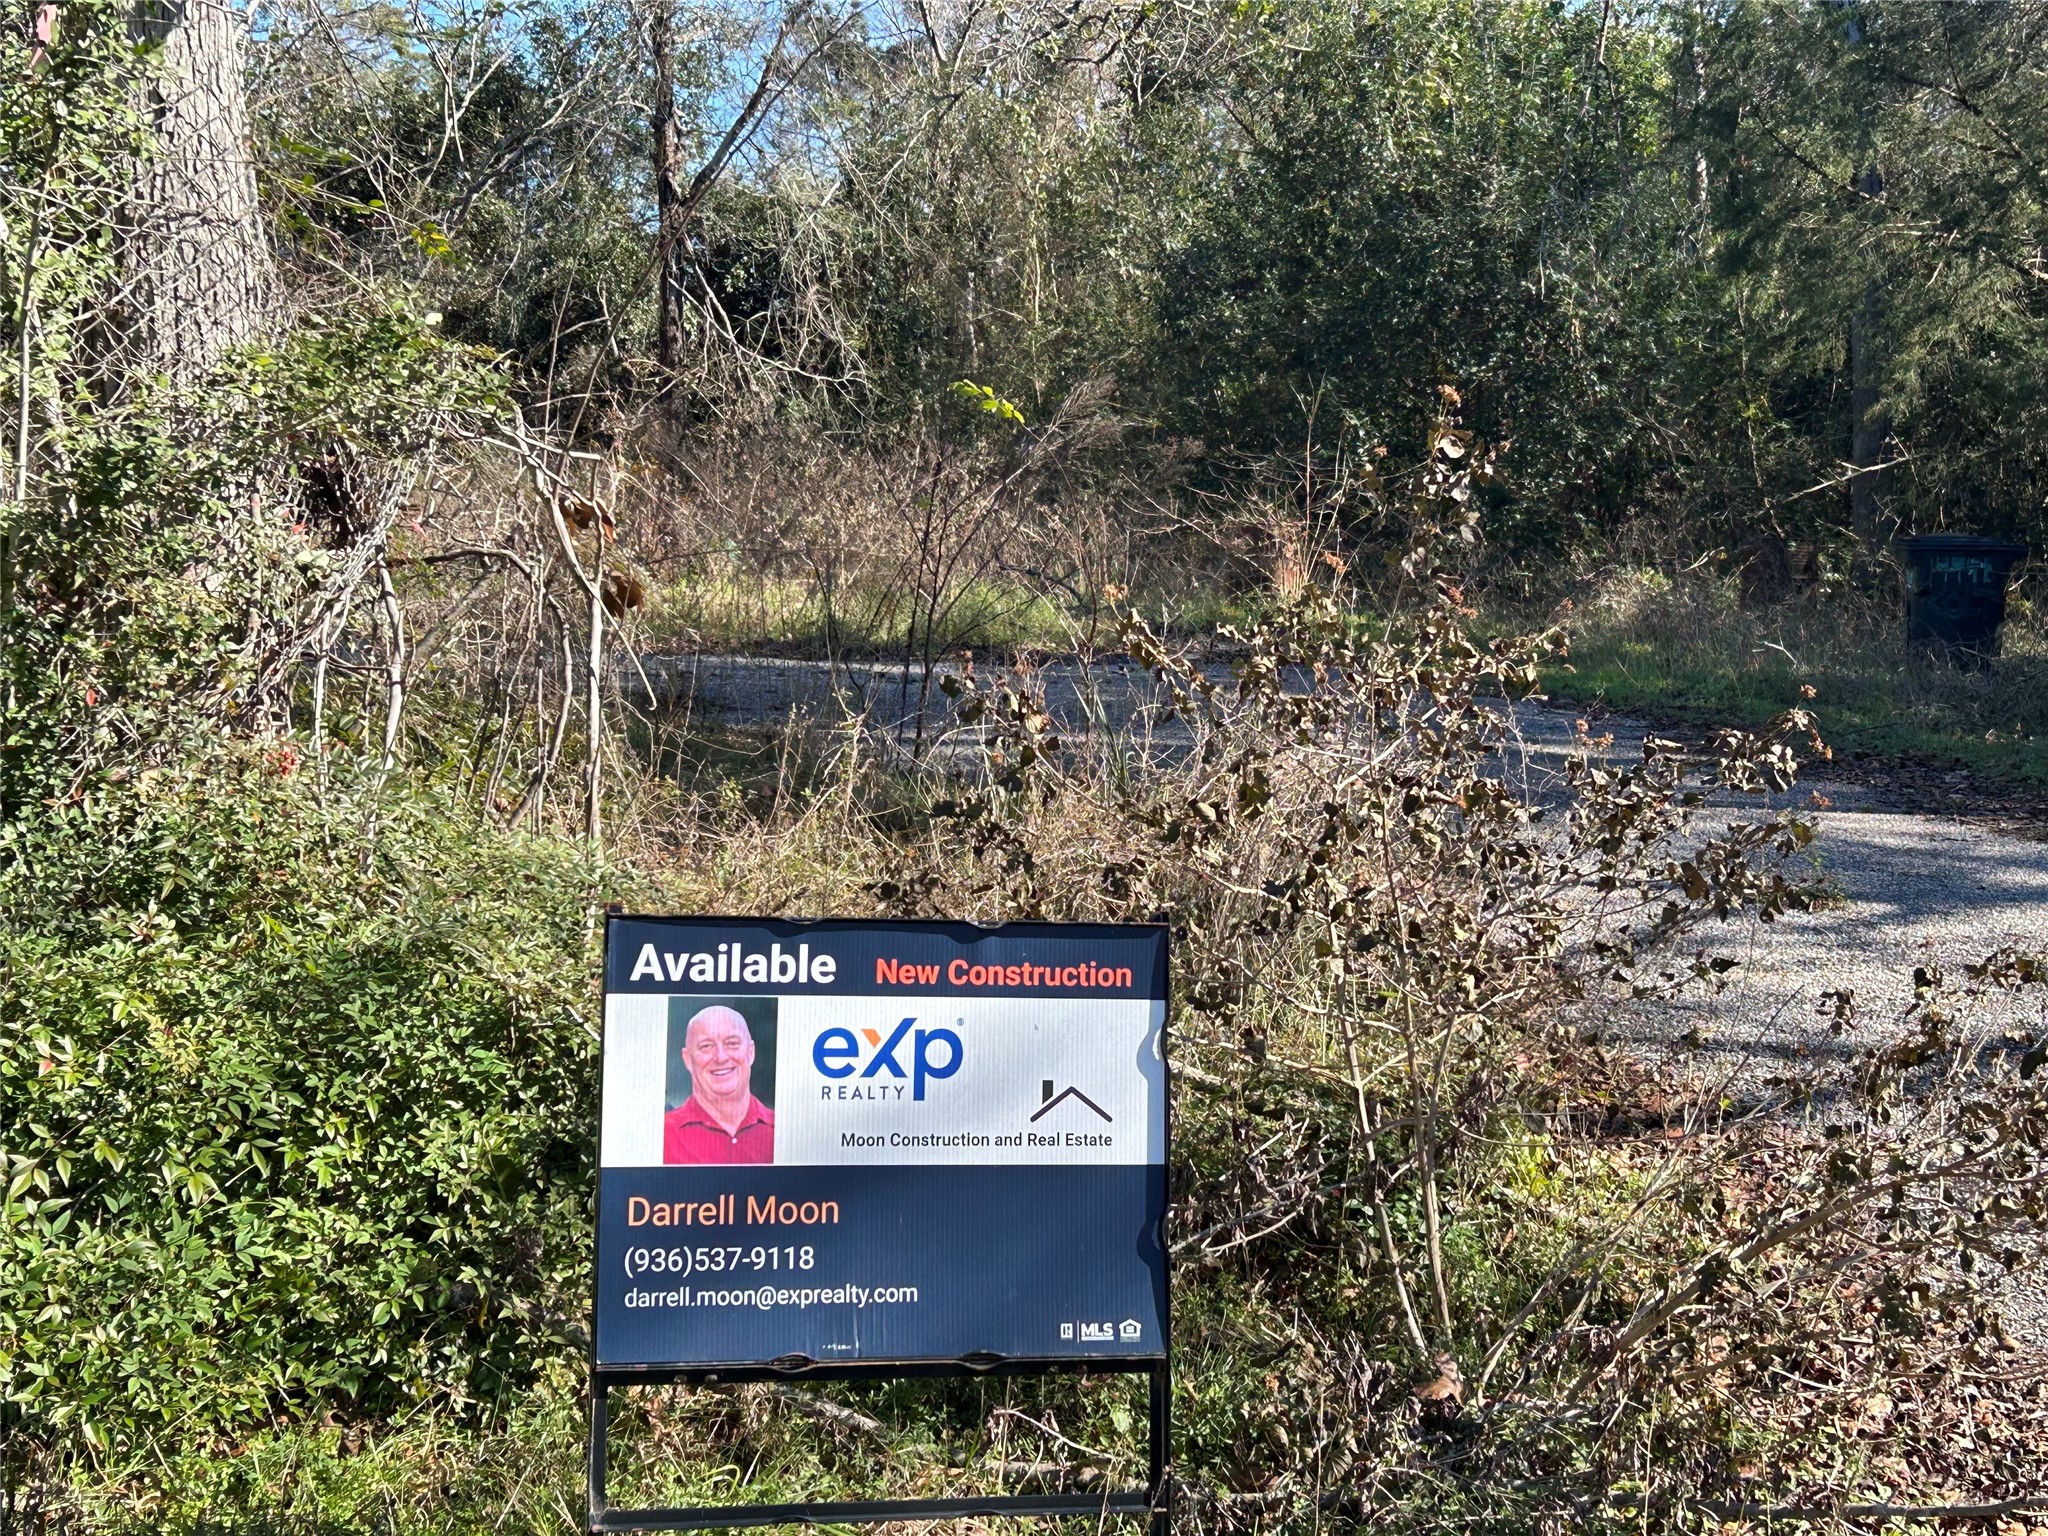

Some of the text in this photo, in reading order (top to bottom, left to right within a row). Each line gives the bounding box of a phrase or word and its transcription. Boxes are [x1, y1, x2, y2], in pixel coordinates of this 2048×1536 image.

[630, 943, 836, 983] Available
[876, 957, 1132, 987] New Construction
[821, 1085, 905, 1100] REALTY
[841, 1132, 1113, 1147] Moon Construction and Real Estate
[627, 1194, 839, 1226] Darrell Moon
[623, 1246, 815, 1278] (936)537-9118
[624, 1283, 918, 1310] darrell.moon@exprealty.com
[1081, 1323, 1114, 1337] MLS
